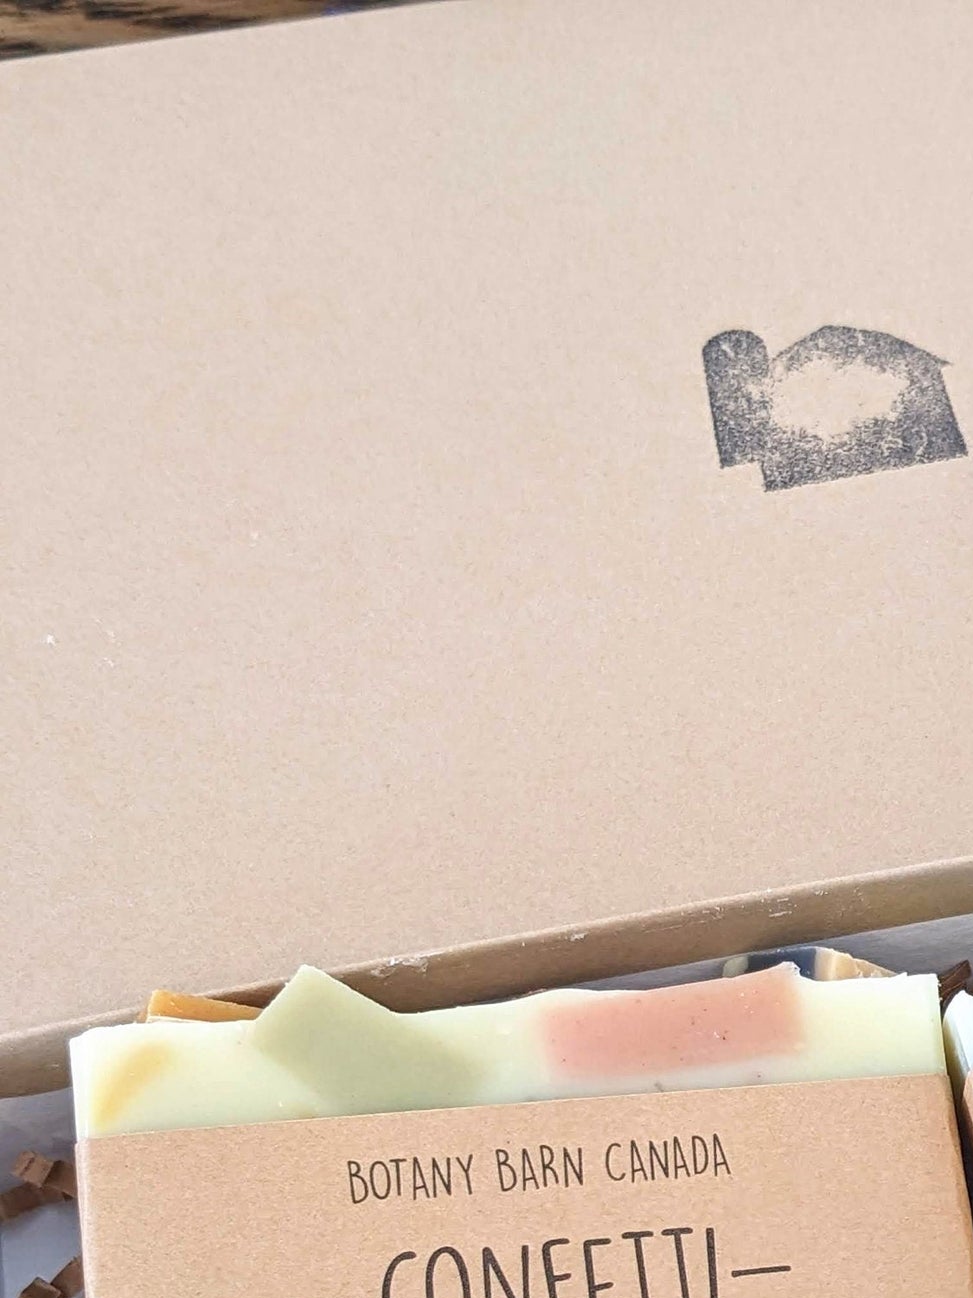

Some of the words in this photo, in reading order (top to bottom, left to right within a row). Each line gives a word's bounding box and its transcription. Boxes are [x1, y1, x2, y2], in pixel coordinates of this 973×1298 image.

[346, 1153, 474, 1205] BOTANY
[494, 1144, 584, 1193] BARN
[604, 1133, 732, 1184] CANADA
